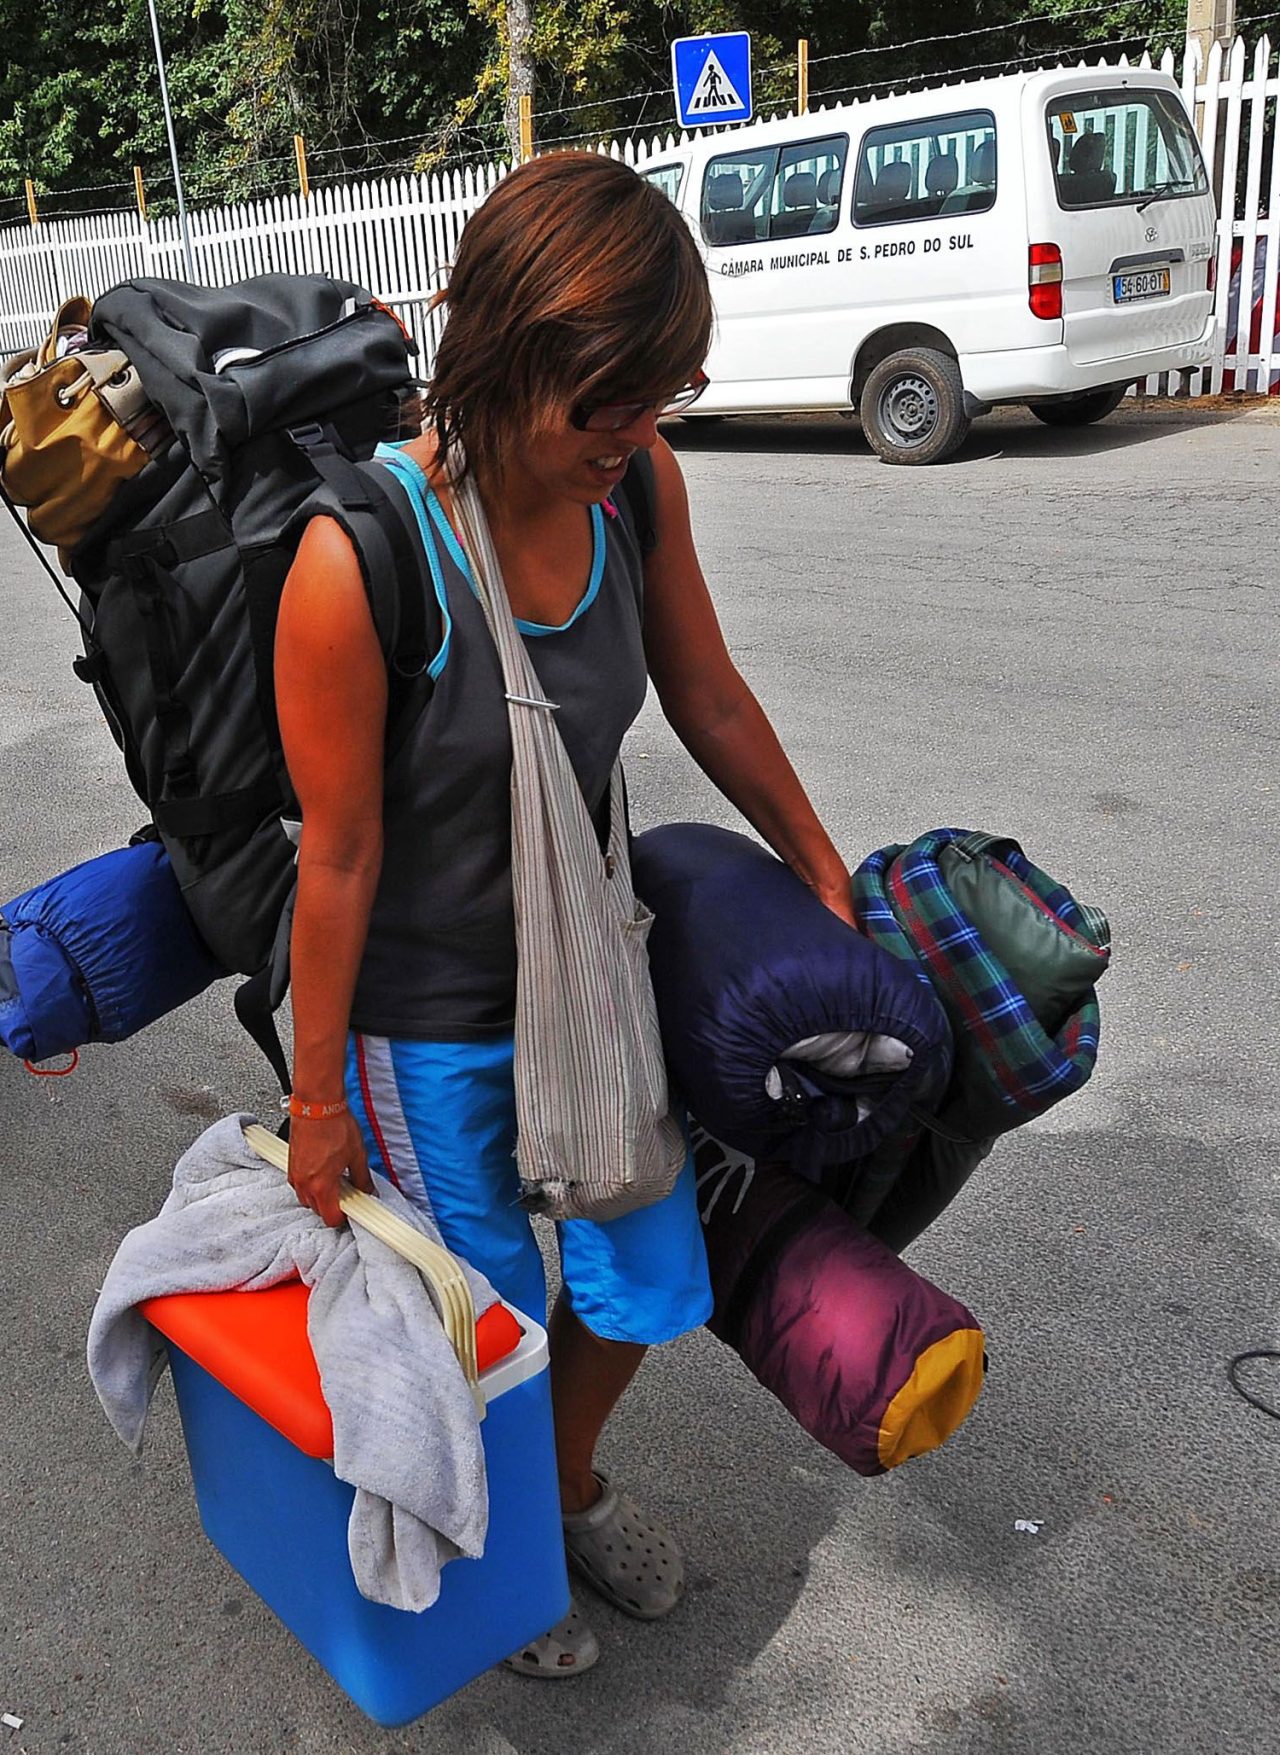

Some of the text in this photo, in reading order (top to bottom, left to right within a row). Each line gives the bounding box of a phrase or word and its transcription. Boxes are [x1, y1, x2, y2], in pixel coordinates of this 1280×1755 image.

[721, 234, 974, 275] CÂMARA MUNICIPAL DE S. PEDRO DO SUL
